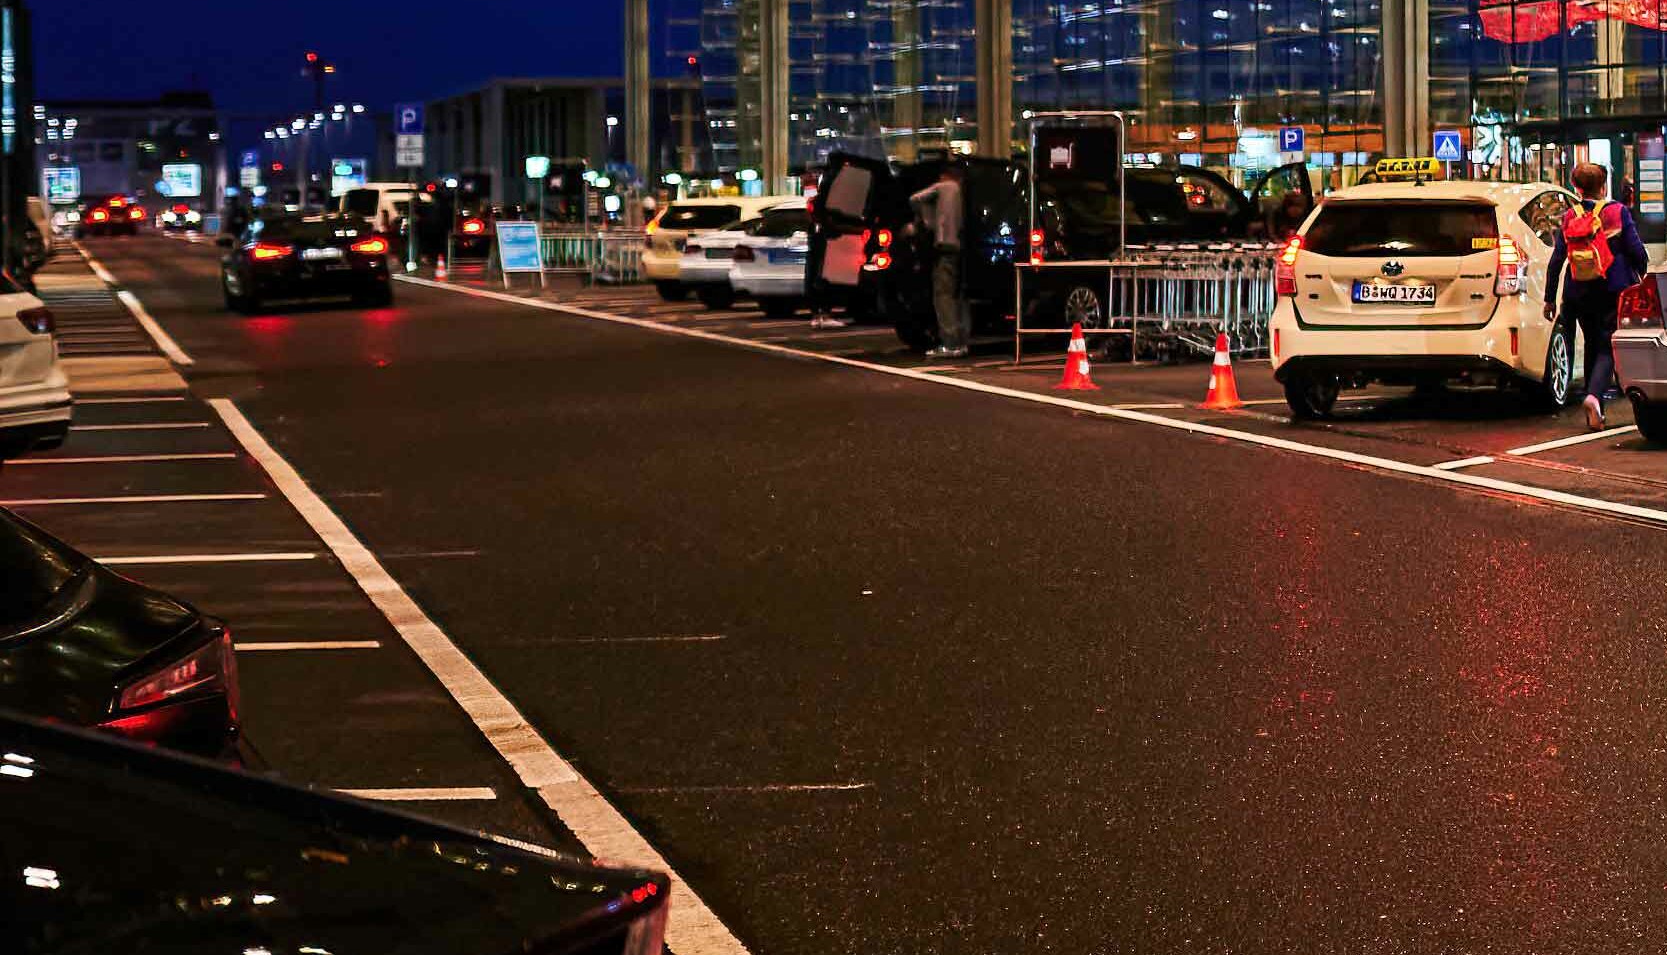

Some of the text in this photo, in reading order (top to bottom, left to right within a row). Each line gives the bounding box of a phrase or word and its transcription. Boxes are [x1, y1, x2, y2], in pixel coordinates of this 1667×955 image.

[1285, 130, 1298, 149] P
[1360, 285, 1370, 300] B
[1400, 284, 1434, 300] 1734
